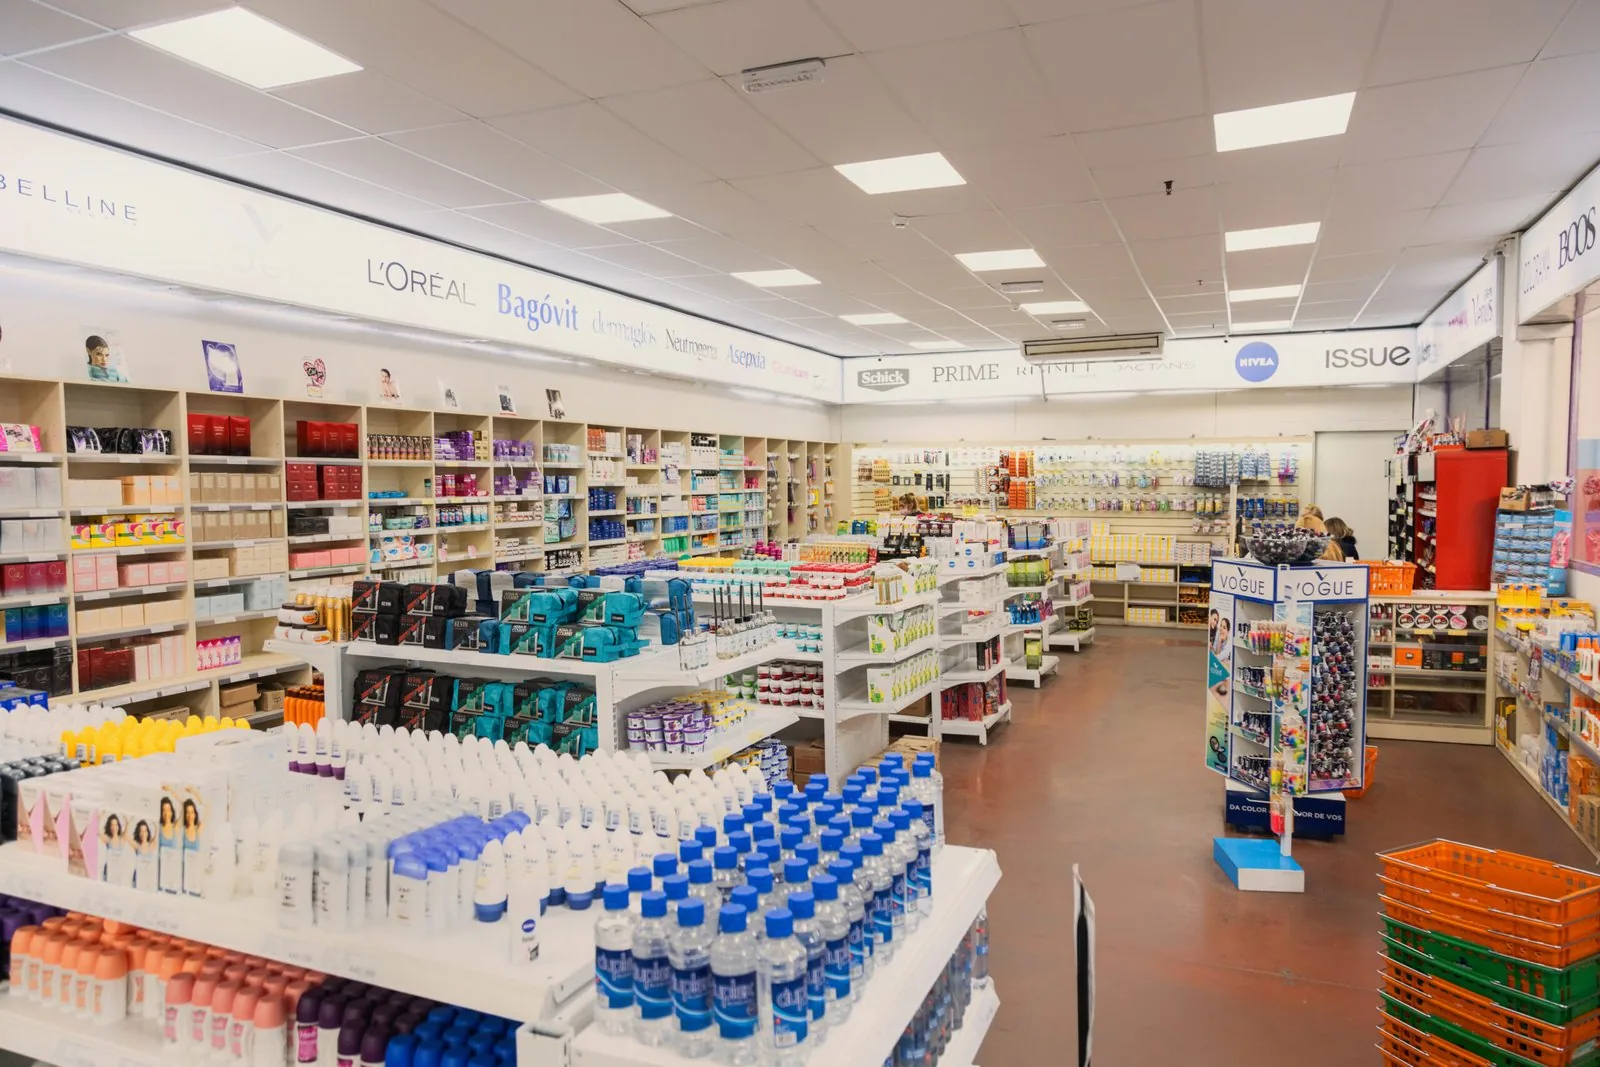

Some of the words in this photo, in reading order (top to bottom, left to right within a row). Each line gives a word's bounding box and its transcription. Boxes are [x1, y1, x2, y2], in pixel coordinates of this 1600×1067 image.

[1557, 205, 1597, 271] BOOS
[497, 283, 579, 332] Bagóvit
[591, 309, 658, 350] dermaglós
[665, 327, 719, 361] Neutrogena
[725, 344, 767, 370] Asepxia
[1239, 356, 1275, 368] NIVEA
[861, 370, 906, 385] Schick
[931, 363, 1000, 383] PRIME
[1220, 574, 1265, 596] VOGUE
[1241, 805, 1267, 813] COLOR
